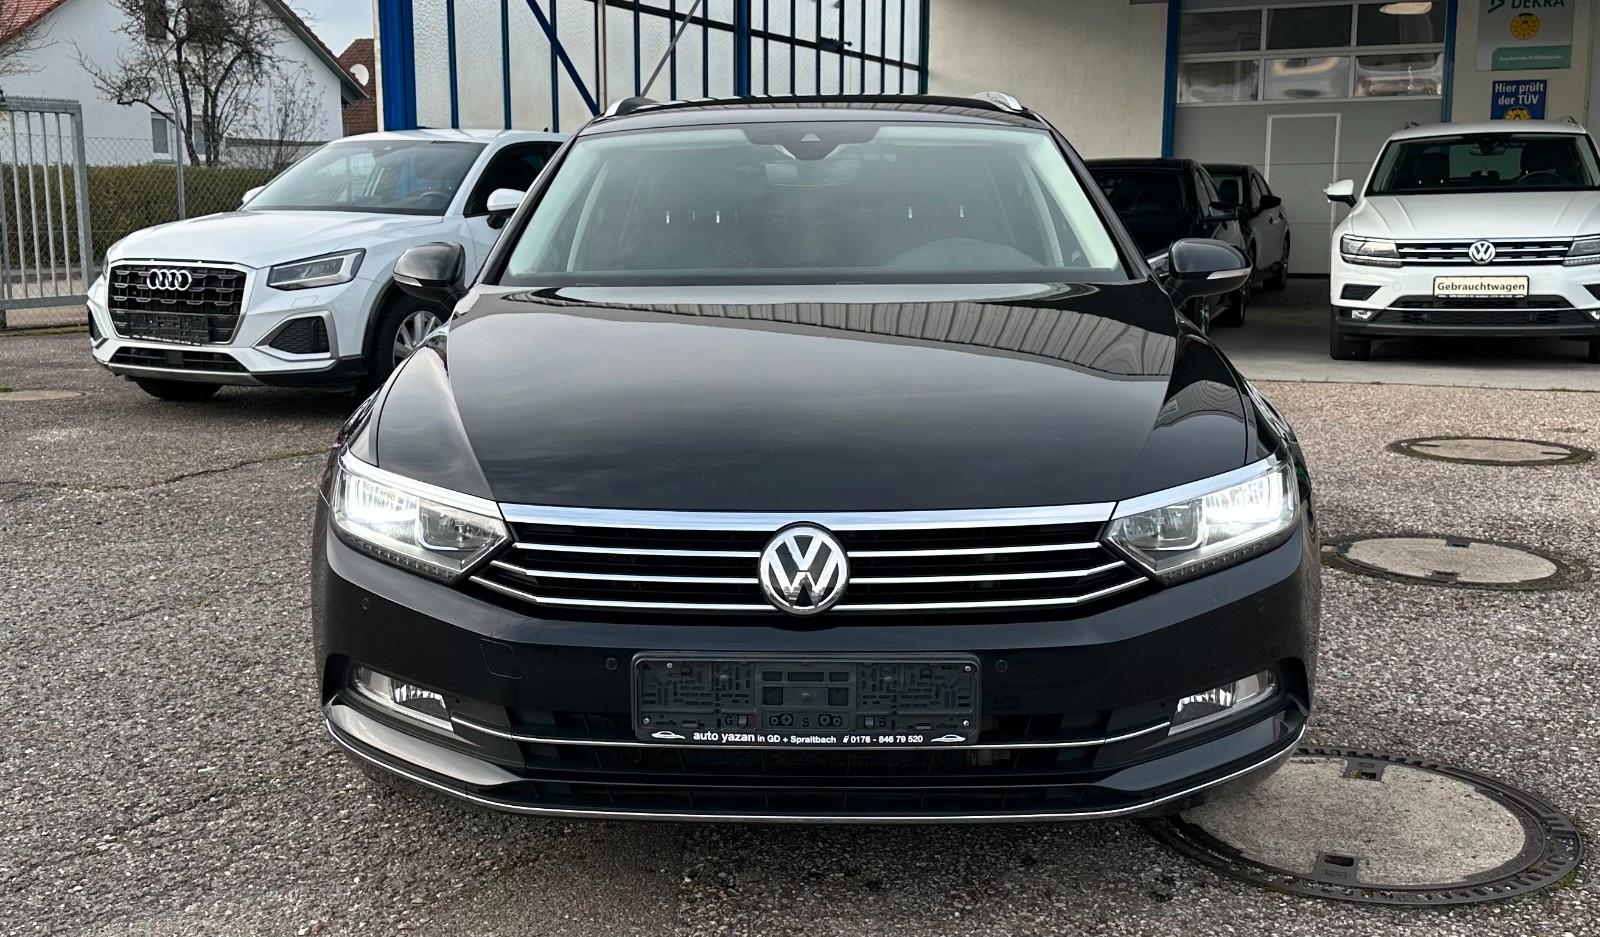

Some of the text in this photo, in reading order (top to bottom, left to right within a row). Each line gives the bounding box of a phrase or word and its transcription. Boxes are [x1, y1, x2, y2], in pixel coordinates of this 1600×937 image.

[1495, 82, 1544, 95] Hier prüft
[1498, 92, 1539, 105] der TÜV
[1468, 240, 1496, 265] VW
[1437, 282, 1525, 292] Gebrauchtwagen
[760, 526, 848, 613] VW
[693, 731, 719, 741] auto
[721, 733, 755, 743] yazan
[757, 734, 765, 742] in
[767, 735, 781, 743] GD
[850, 735, 871, 743] 0176
[896, 735, 906, 743] 79
[907, 735, 924, 743] 520
